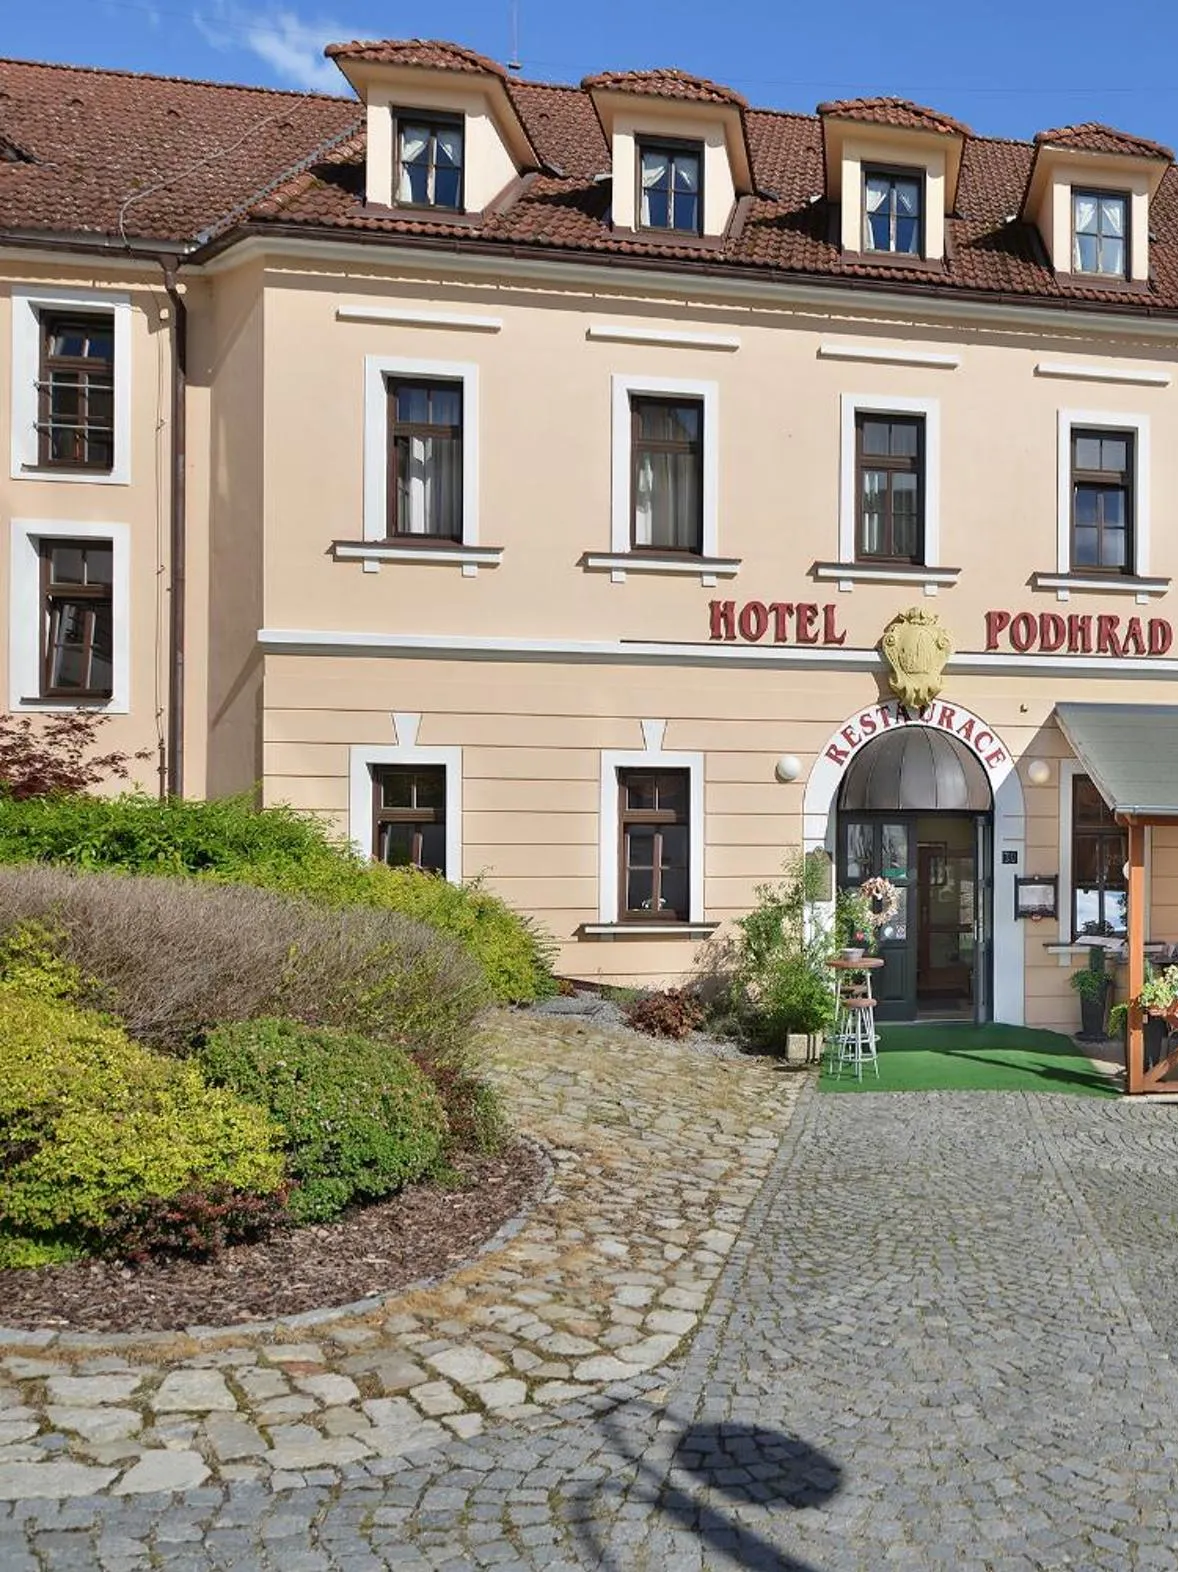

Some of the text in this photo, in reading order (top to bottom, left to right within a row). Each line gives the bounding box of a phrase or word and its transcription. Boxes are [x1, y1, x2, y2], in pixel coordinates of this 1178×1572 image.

[708, 600, 1173, 657] HOTEL PODHRAD
[825, 703, 1006, 769] RESTAURACE
